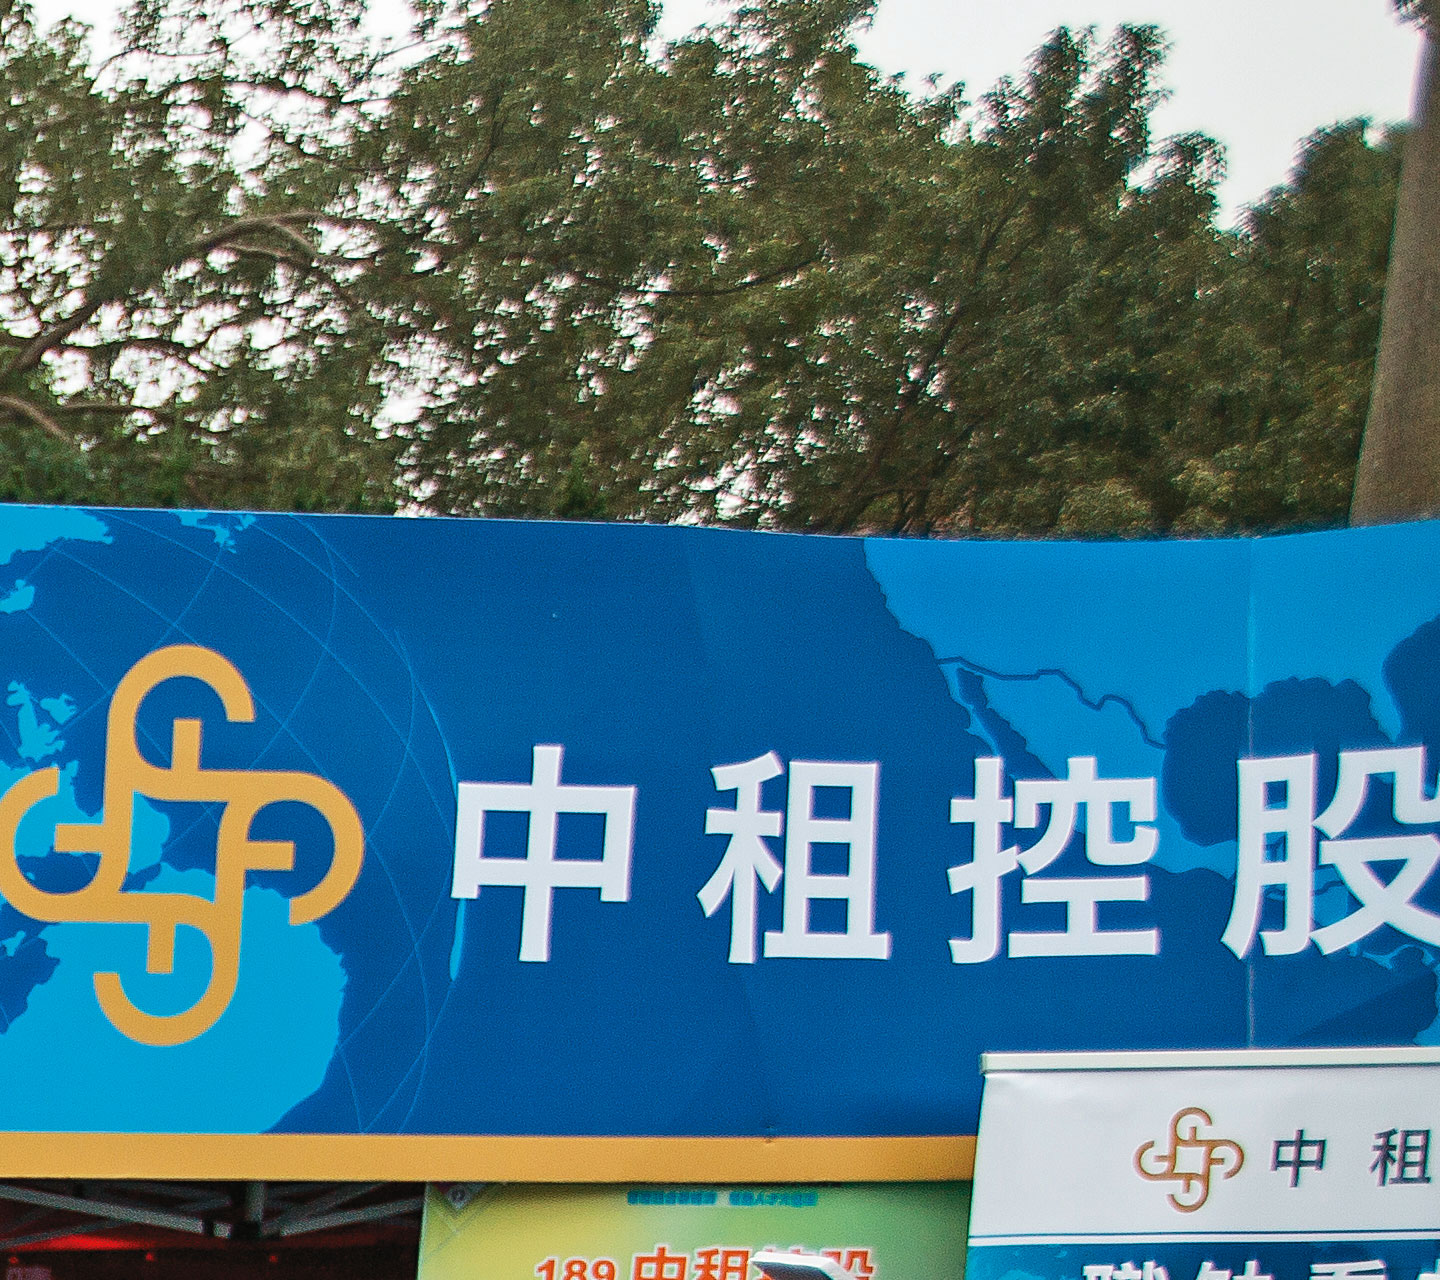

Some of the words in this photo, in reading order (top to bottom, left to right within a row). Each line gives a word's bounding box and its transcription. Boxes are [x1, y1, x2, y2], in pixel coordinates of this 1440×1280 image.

[451, 745, 1440, 966] 中租控股
[1271, 1128, 1432, 1188] 中租
